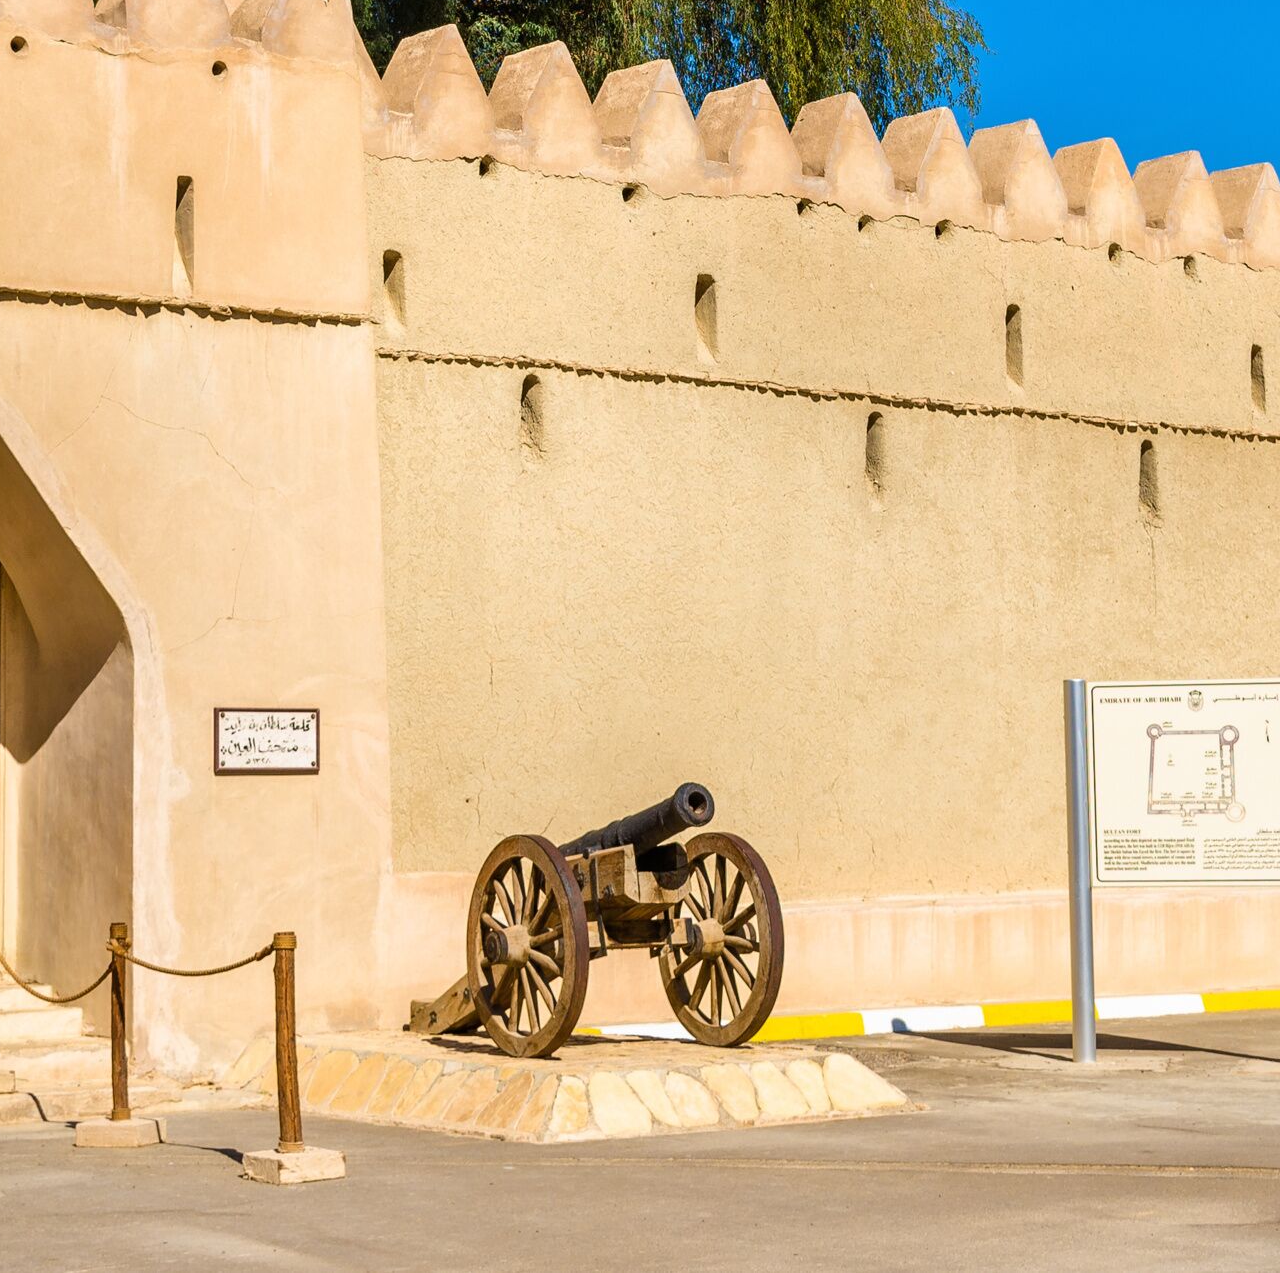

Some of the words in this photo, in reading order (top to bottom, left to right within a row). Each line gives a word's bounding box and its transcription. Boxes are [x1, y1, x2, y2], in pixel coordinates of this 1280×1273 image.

[289, 716, 311, 732] قلعة
[227, 737, 257, 756] العين
[258, 738, 299, 753] متحف
